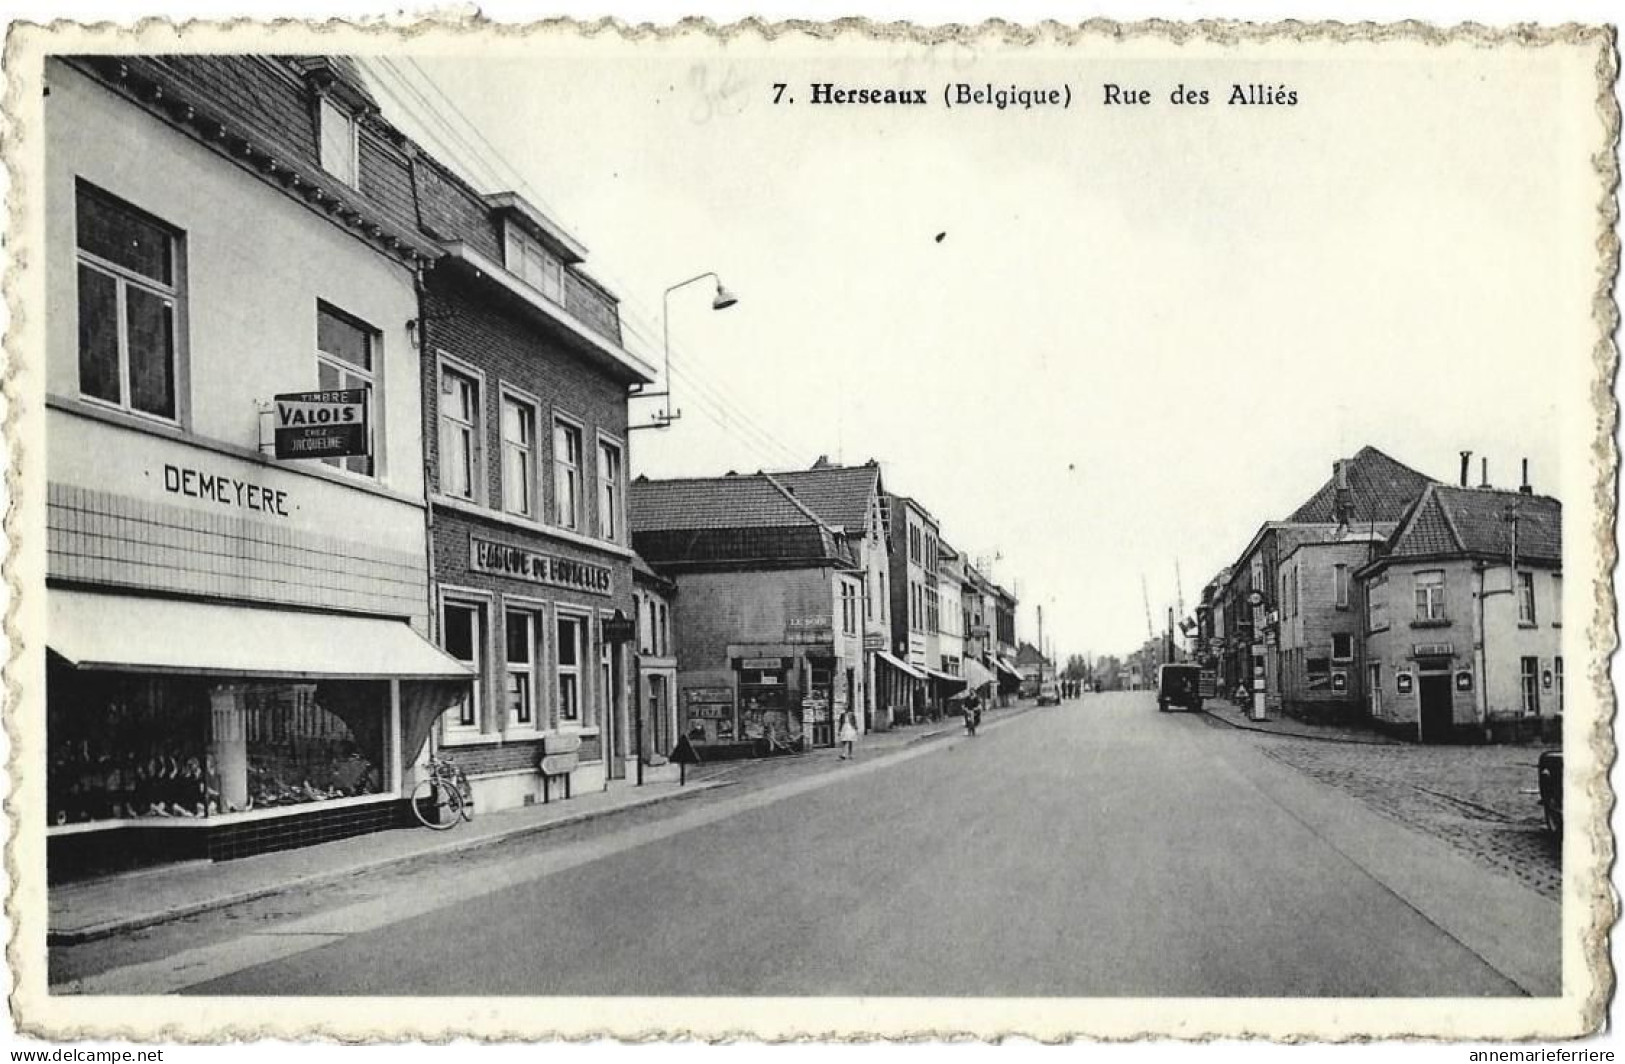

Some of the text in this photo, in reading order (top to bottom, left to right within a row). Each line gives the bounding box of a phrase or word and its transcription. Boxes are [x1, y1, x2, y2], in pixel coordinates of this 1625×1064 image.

[301, 392, 349, 403] TIMBRE
[278, 401, 355, 425] VALOIS
[164, 463, 289, 516] DEMEYERE
